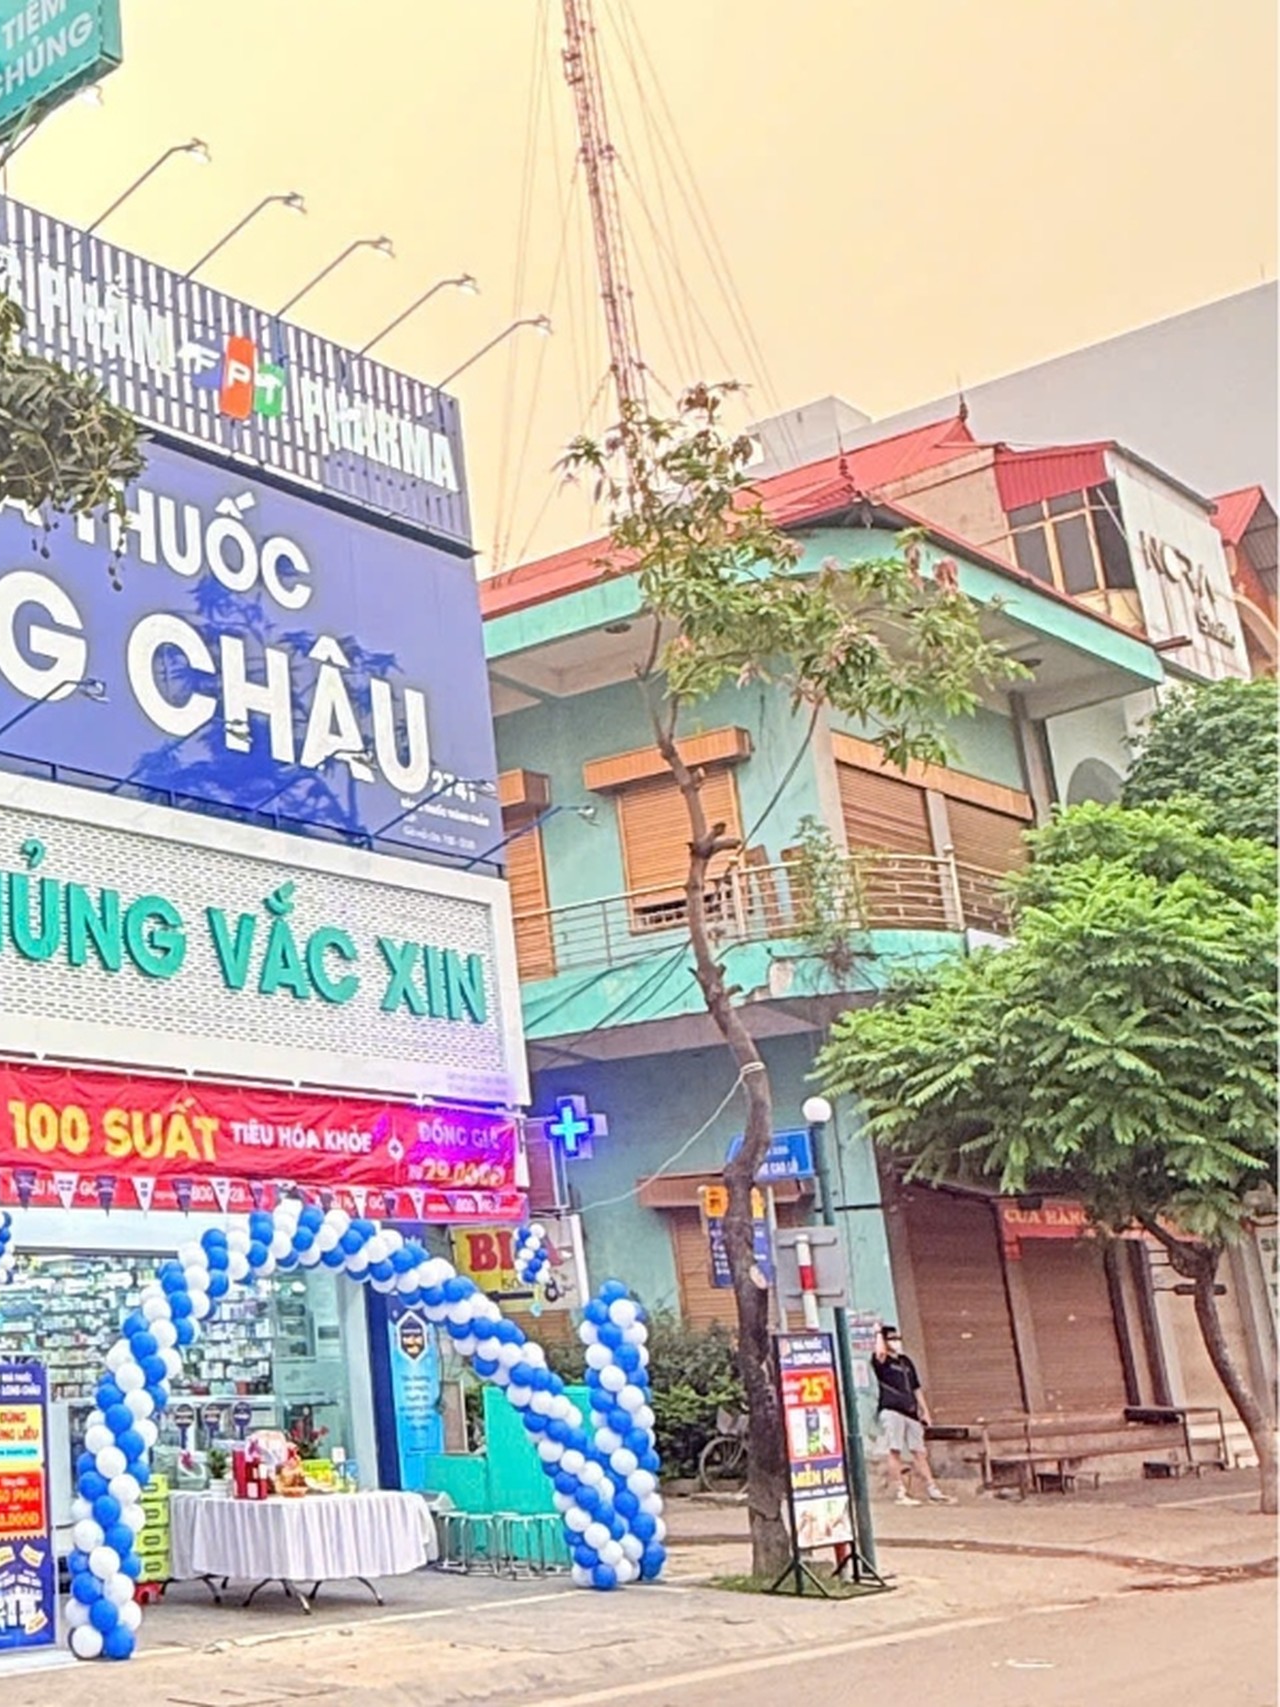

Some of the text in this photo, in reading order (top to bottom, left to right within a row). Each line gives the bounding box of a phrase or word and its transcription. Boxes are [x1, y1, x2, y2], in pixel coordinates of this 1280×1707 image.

[179, 341, 280, 406] FPT
[301, 370, 459, 492] PHARMA
[126, 611, 432, 794] CHÂU
[206, 880, 359, 1004] VẮC
[376, 934, 488, 1022] XIN
[8, 1099, 91, 1154] 100
[102, 1096, 219, 1163] SUẤT
[230, 1117, 272, 1147] TIÊU
[276, 1120, 322, 1150] HÓA
